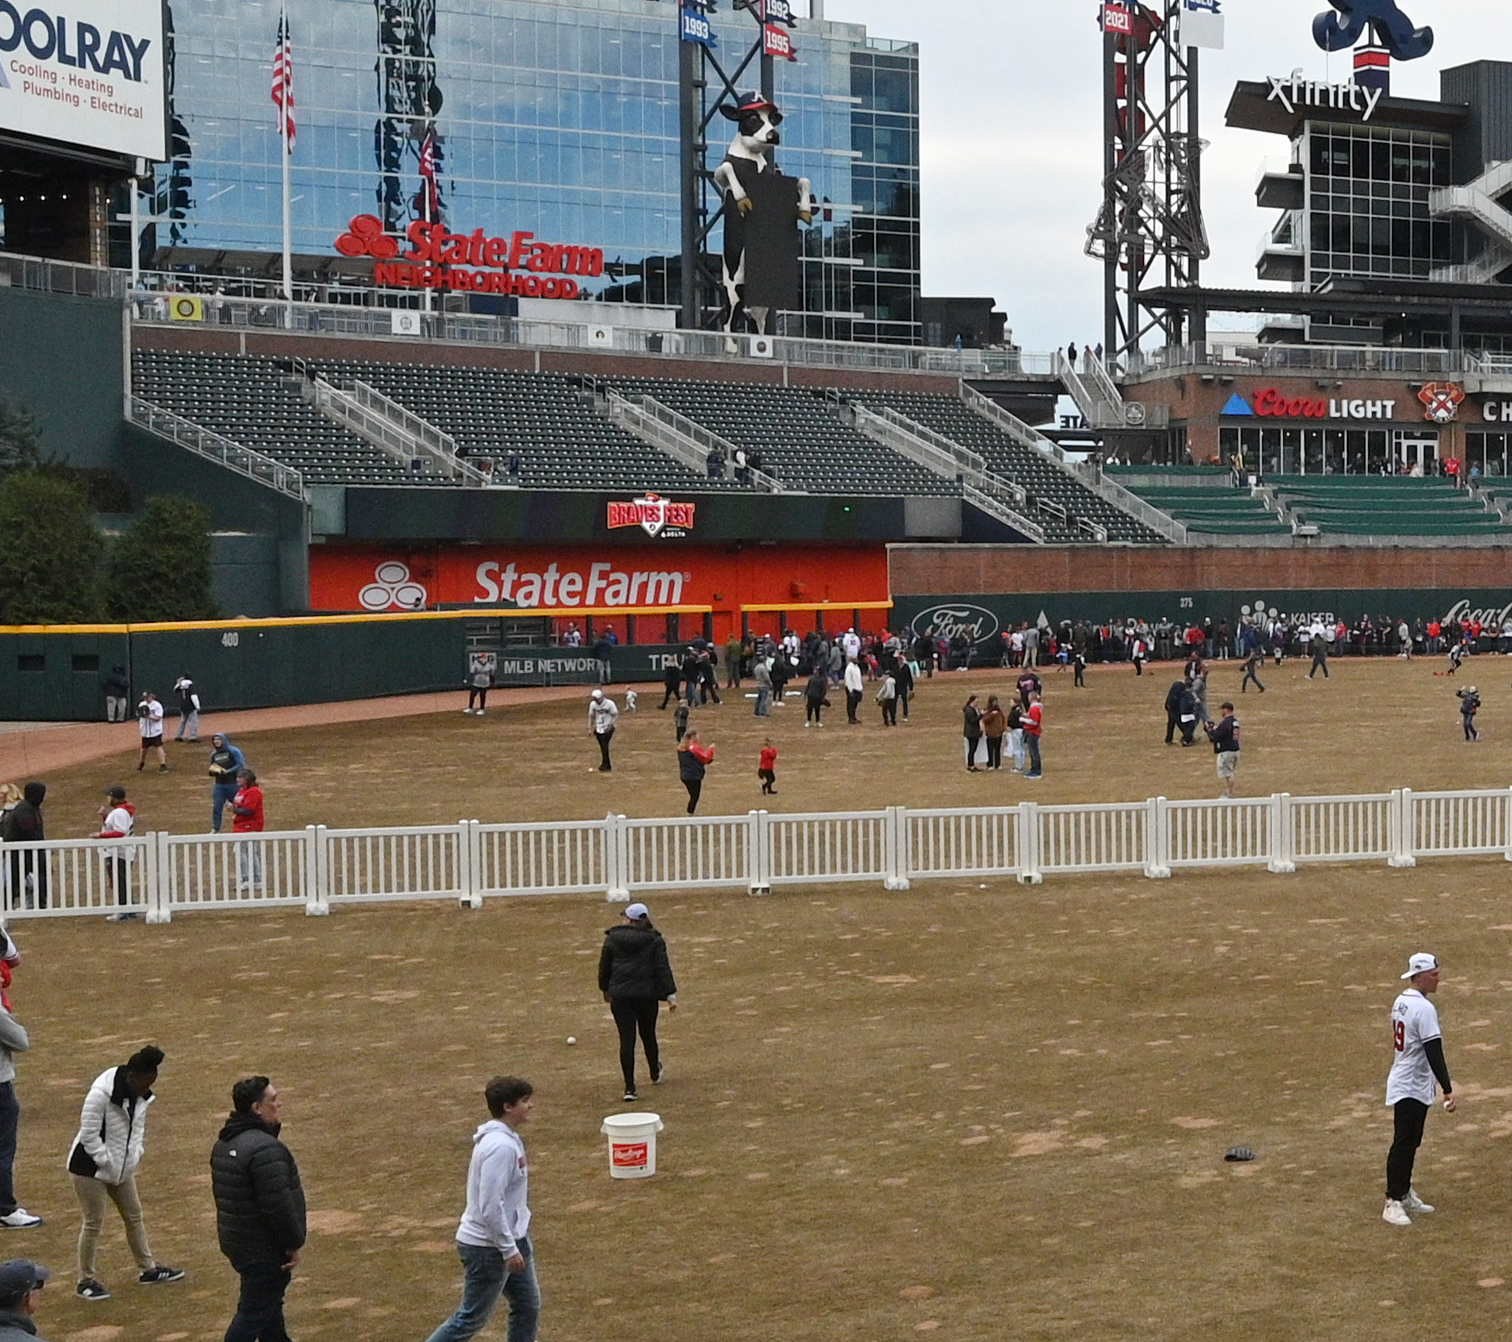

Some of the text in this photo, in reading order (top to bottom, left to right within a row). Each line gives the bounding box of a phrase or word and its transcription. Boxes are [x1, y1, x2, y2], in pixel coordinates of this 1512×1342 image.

[684, 15, 709, 40] 1993
[1105, 10, 1130, 30] 2021
[765, 28, 790, 54] 1995
[10, 59, 114, 97] Cooling Heating
[23, 80, 144, 119] Plumbing Electrical
[1266, 67, 1383, 122] xfinity
[374, 262, 579, 300] NEIGHBORHOOD
[1252, 387, 1396, 419] Coors LIGHT
[609, 503, 695, 528] BRAVES FEST
[1179, 596, 1194, 609] 375
[221, 631, 239, 648] 400
[503, 657, 603, 675] MLB NETWOR
